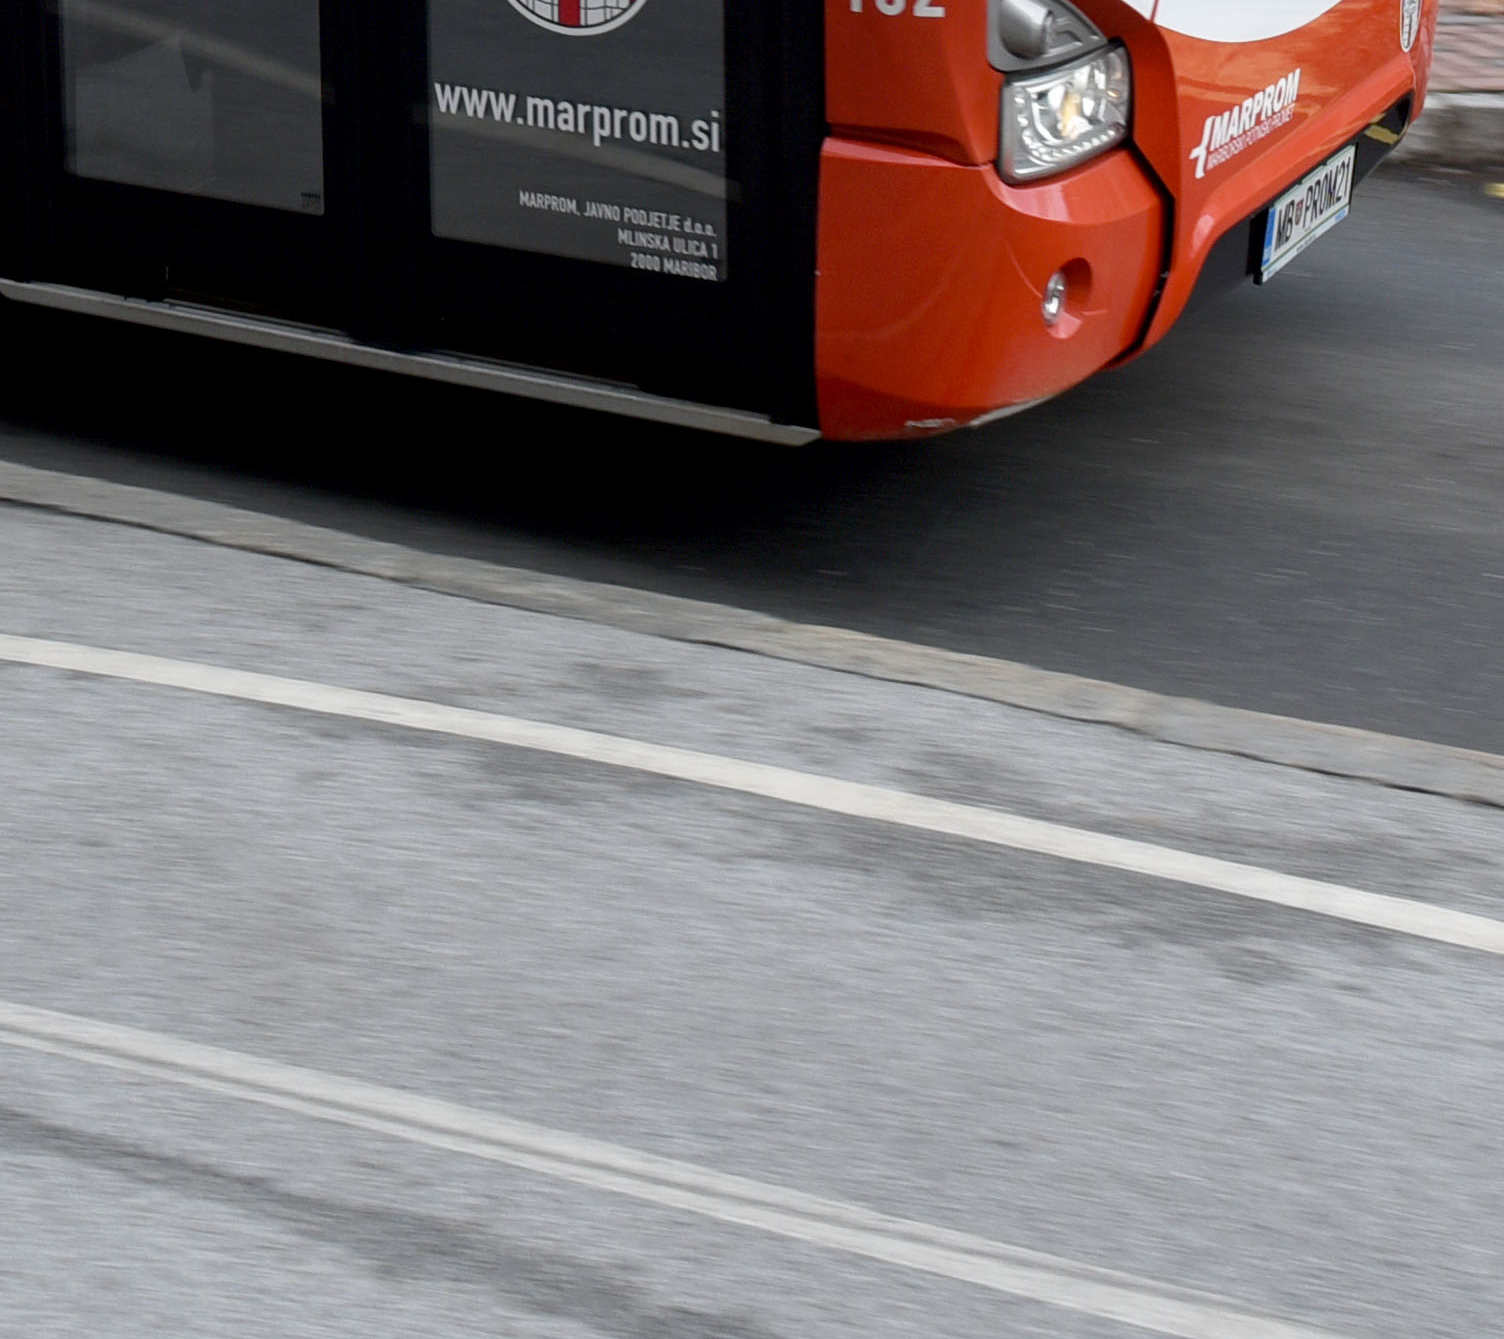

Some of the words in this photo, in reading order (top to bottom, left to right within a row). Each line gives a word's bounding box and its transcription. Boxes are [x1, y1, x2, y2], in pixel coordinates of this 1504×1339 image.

[433, 81, 721, 153] www.marprom.si
[1209, 67, 1301, 152] MARPROM
[583, 200, 621, 222] JAVNO
[623, 207, 681, 232] PODJETJE
[683, 217, 718, 237] d.o.o.
[1274, 199, 1295, 252] MB
[617, 228, 670, 251] MLINSKA
[673, 237, 708, 259] ULICA
[711, 243, 718, 259] 1
[630, 253, 661, 272] 2000
[663, 257, 718, 281] MARIBOR
